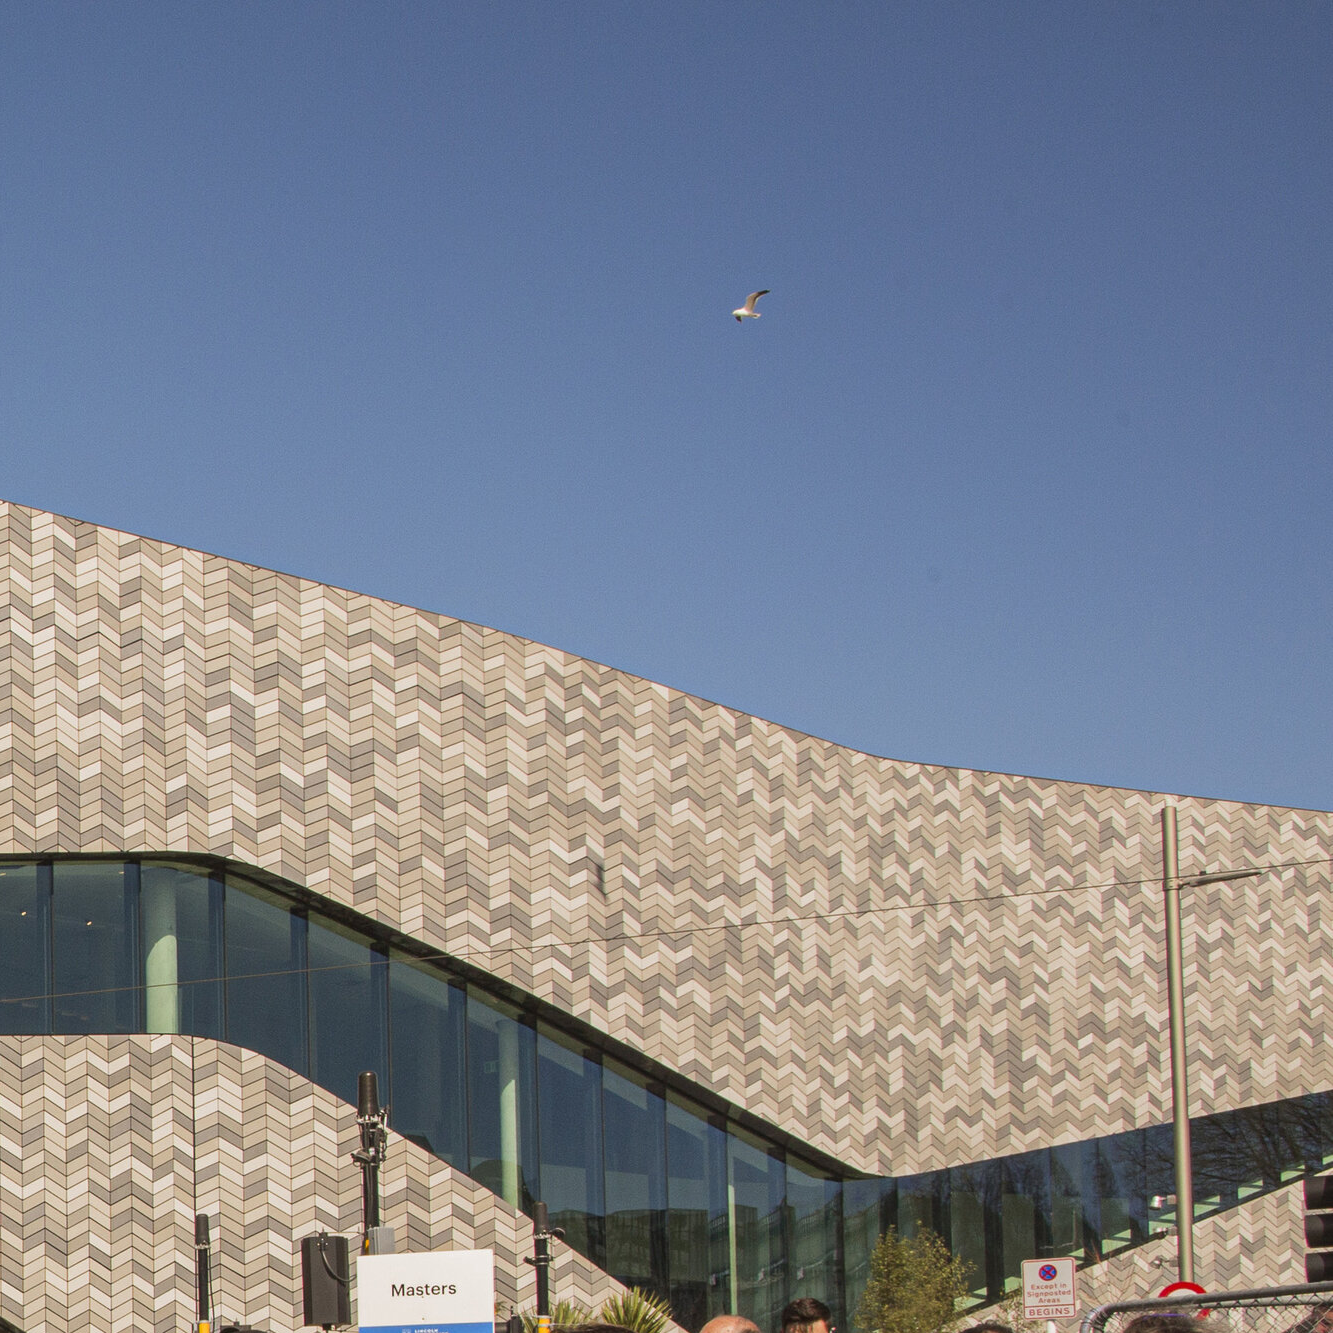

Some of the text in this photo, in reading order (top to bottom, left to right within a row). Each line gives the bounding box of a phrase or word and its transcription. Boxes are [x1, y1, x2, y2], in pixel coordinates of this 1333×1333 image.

[391, 1283, 457, 1297] Masters
[1027, 1289, 1071, 1298] Signposted
[1029, 1308, 1070, 1316] BEGINS
